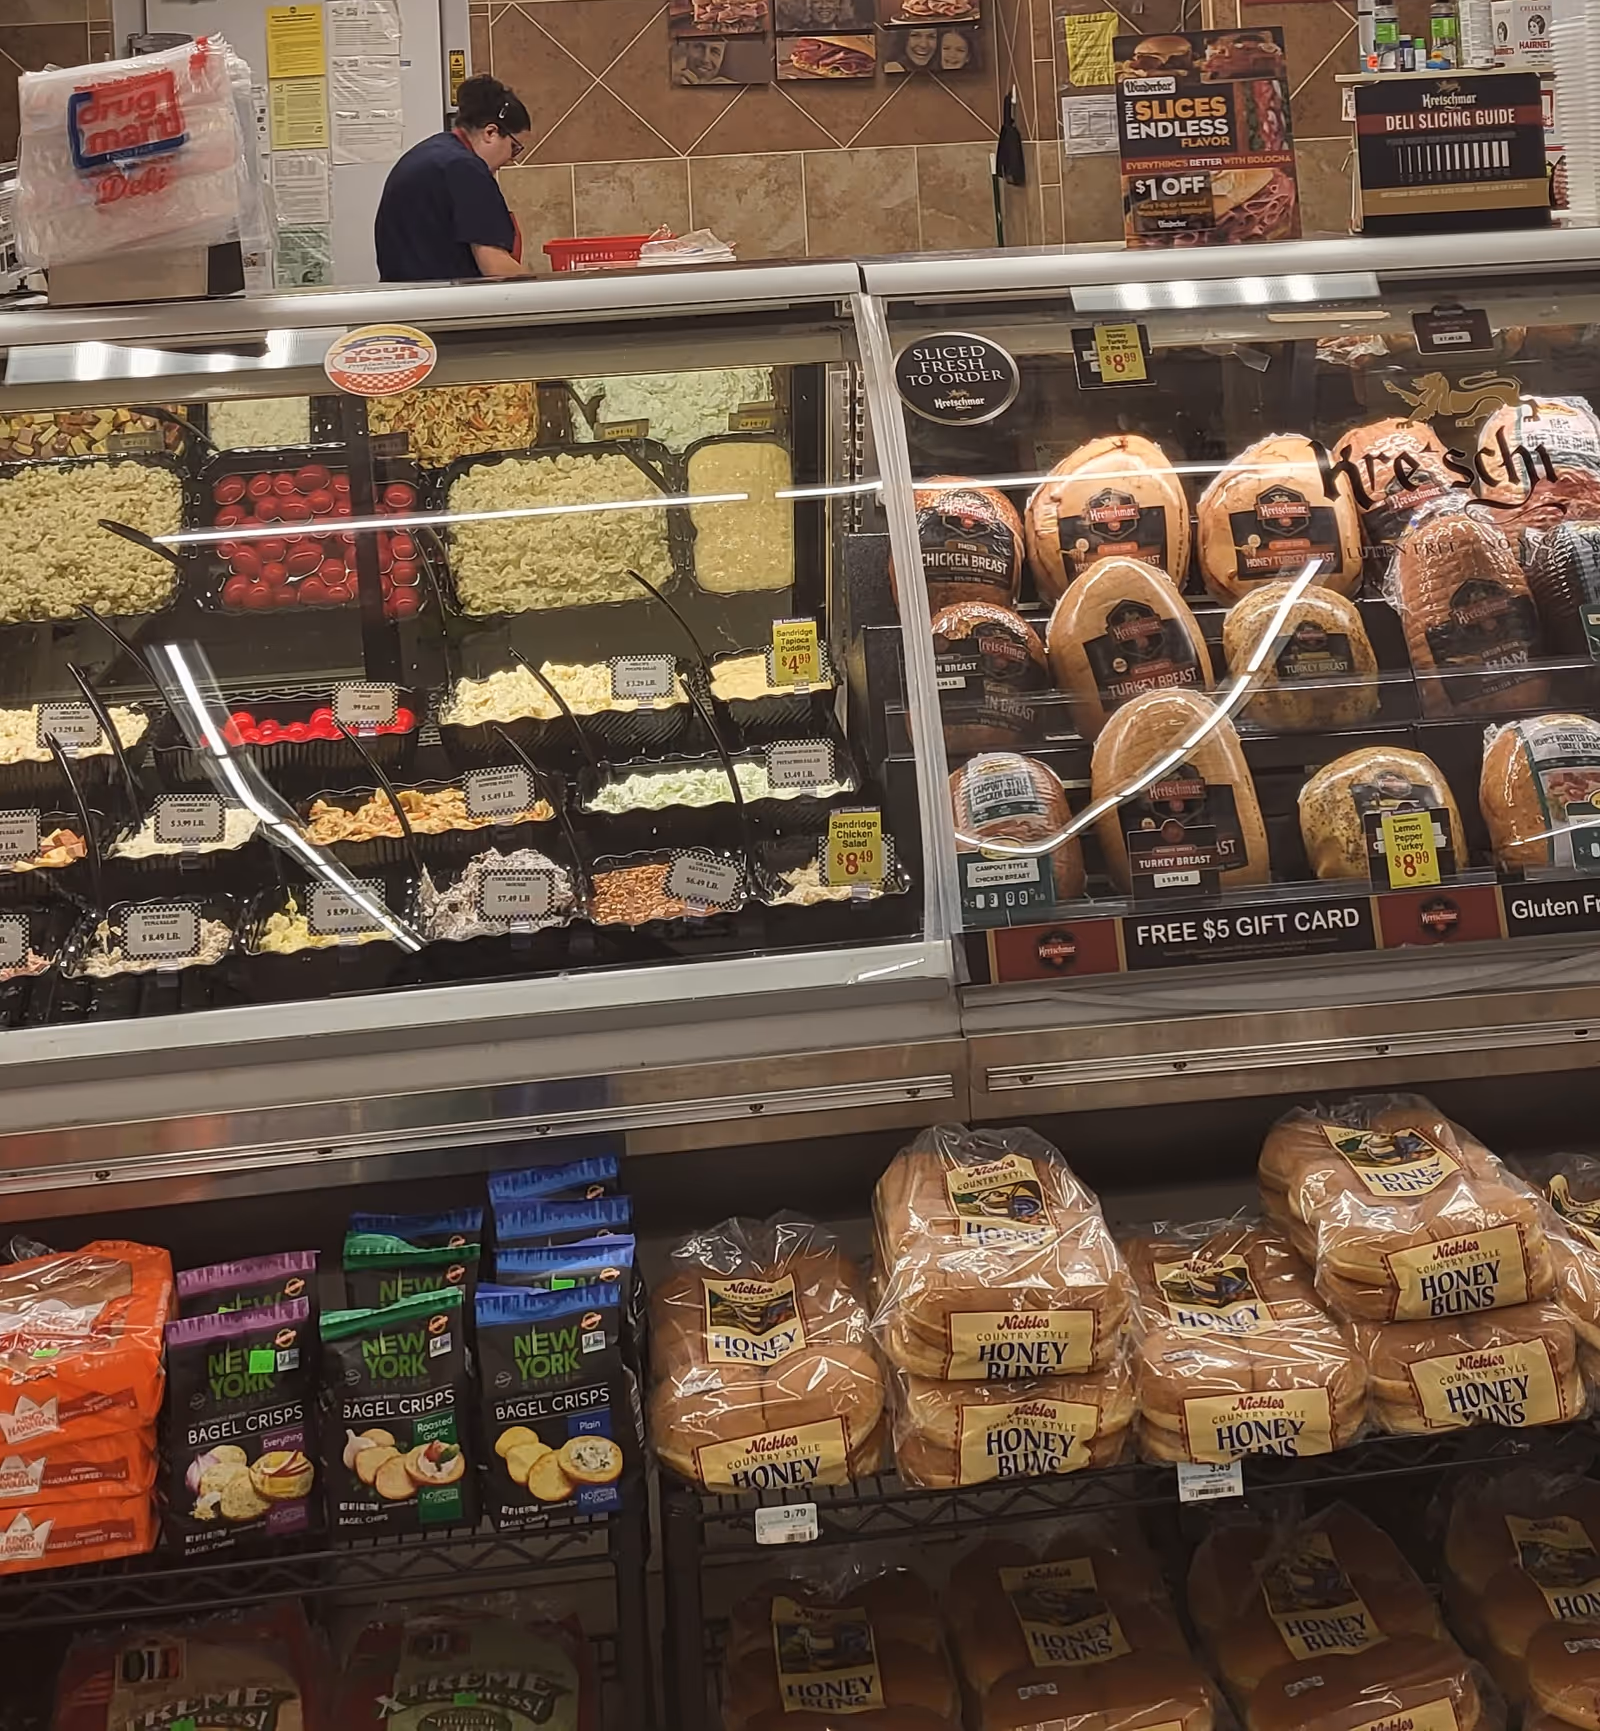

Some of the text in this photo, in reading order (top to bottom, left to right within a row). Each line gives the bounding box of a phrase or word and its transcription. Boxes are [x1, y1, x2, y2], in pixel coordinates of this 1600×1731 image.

[78, 90, 156, 125] drug
[1125, 101, 1134, 123] THIN
[1135, 97, 1227, 121] SLICES
[1422, 92, 1477, 110] Kretschmar
[1126, 118, 1229, 140] ENDLESS
[1386, 108, 1516, 131] DELI SLICING GUIDE
[1181, 136, 1231, 148] FLAVOR
[1189, 158, 1222, 167] BETTER
[1247, 155, 1291, 164] BOLOGNA
[94, 167, 169, 206] Deli
[1135, 176, 1205, 201] $1 OFF
[912, 344, 987, 362] SLICED
[920, 357, 985, 373] FRESH
[906, 369, 1005, 386] TO ORDER
[934, 395, 986, 411] Kretschmar
[921, 553, 1008, 574] CHICKEN BREAST
[776, 629, 813, 637] Sandridge
[780, 638, 809, 646] Tapioca
[780, 645, 811, 654] Pudding
[1108, 667, 1197, 697] TURKEY BREAST
[832, 820, 878, 829] Sandridge
[836, 830, 873, 839] Chicken
[1393, 824, 1421, 833] Lemon
[842, 839, 867, 848] Salad
[1394, 833, 1423, 842] Pepper
[1396, 842, 1424, 851] Turkey
[1139, 855, 1211, 868] TURKEY BREAST
[975, 872, 1030, 883] CHICKEN BREAST
[1511, 899, 1579, 919] Gluten
[1136, 908, 1360, 945] FREE $5 GIFT CARD
[957, 1176, 998, 1191] COUNTRY
[1432, 1239, 1479, 1260] Nickles
[1416, 1249, 1500, 1274] COUNTRY STYLE
[1420, 1260, 1501, 1301] HONEY
[1430, 1286, 1495, 1316] BUNS
[997, 1314, 1050, 1330] Nickles
[1177, 1304, 1261, 1327] HONEY
[361, 1330, 426, 1358] NEW
[513, 1325, 578, 1358] NEW
[715, 1328, 797, 1352] HONEY
[976, 1331, 1070, 1341] COUNTRY STYLE
[978, 1342, 1069, 1365] HONEY
[1455, 1353, 1505, 1371] Nickles
[364, 1352, 428, 1379] YORK
[515, 1348, 581, 1382] YORK
[1439, 1363, 1528, 1386] COUNTRY STYLE
[209, 1370, 275, 1400] YORK
[1446, 1375, 1529, 1414] HONEY
[343, 1389, 455, 1419] BAGEL CRISPS
[495, 1388, 610, 1420] BAGEL CRISPS
[1232, 1396, 1285, 1412] Nickles
[7, 1415, 55, 1437] HAWAIIAN
[188, 1405, 304, 1445] BAGEL CRISPS
[417, 1417, 453, 1433] Roasted
[579, 1419, 601, 1431] Plain
[1042, 1421, 1077, 1433] STYLE
[1212, 1411, 1264, 1425] COUNTRY
[263, 1432, 303, 1450] Everything
[423, 1427, 449, 1441] Garlic
[745, 1434, 798, 1455] Nickles
[986, 1428, 1075, 1458] HONEY
[1216, 1418, 1306, 1451] HONEY
[727, 1444, 821, 1470] COUNTRY STYLE
[998, 1451, 1061, 1478] BUNS
[732, 1456, 821, 1490] HONEY
[783, 1508, 807, 1519] 3.79
[1031, 1622, 1113, 1648] HONEY
[1285, 1613, 1366, 1638] HONEY
[1045, 1639, 1113, 1662] BUNS
[1302, 1631, 1369, 1653] BUNS
[786, 1675, 874, 1699] HONEY
[800, 1693, 867, 1708] BUNS
